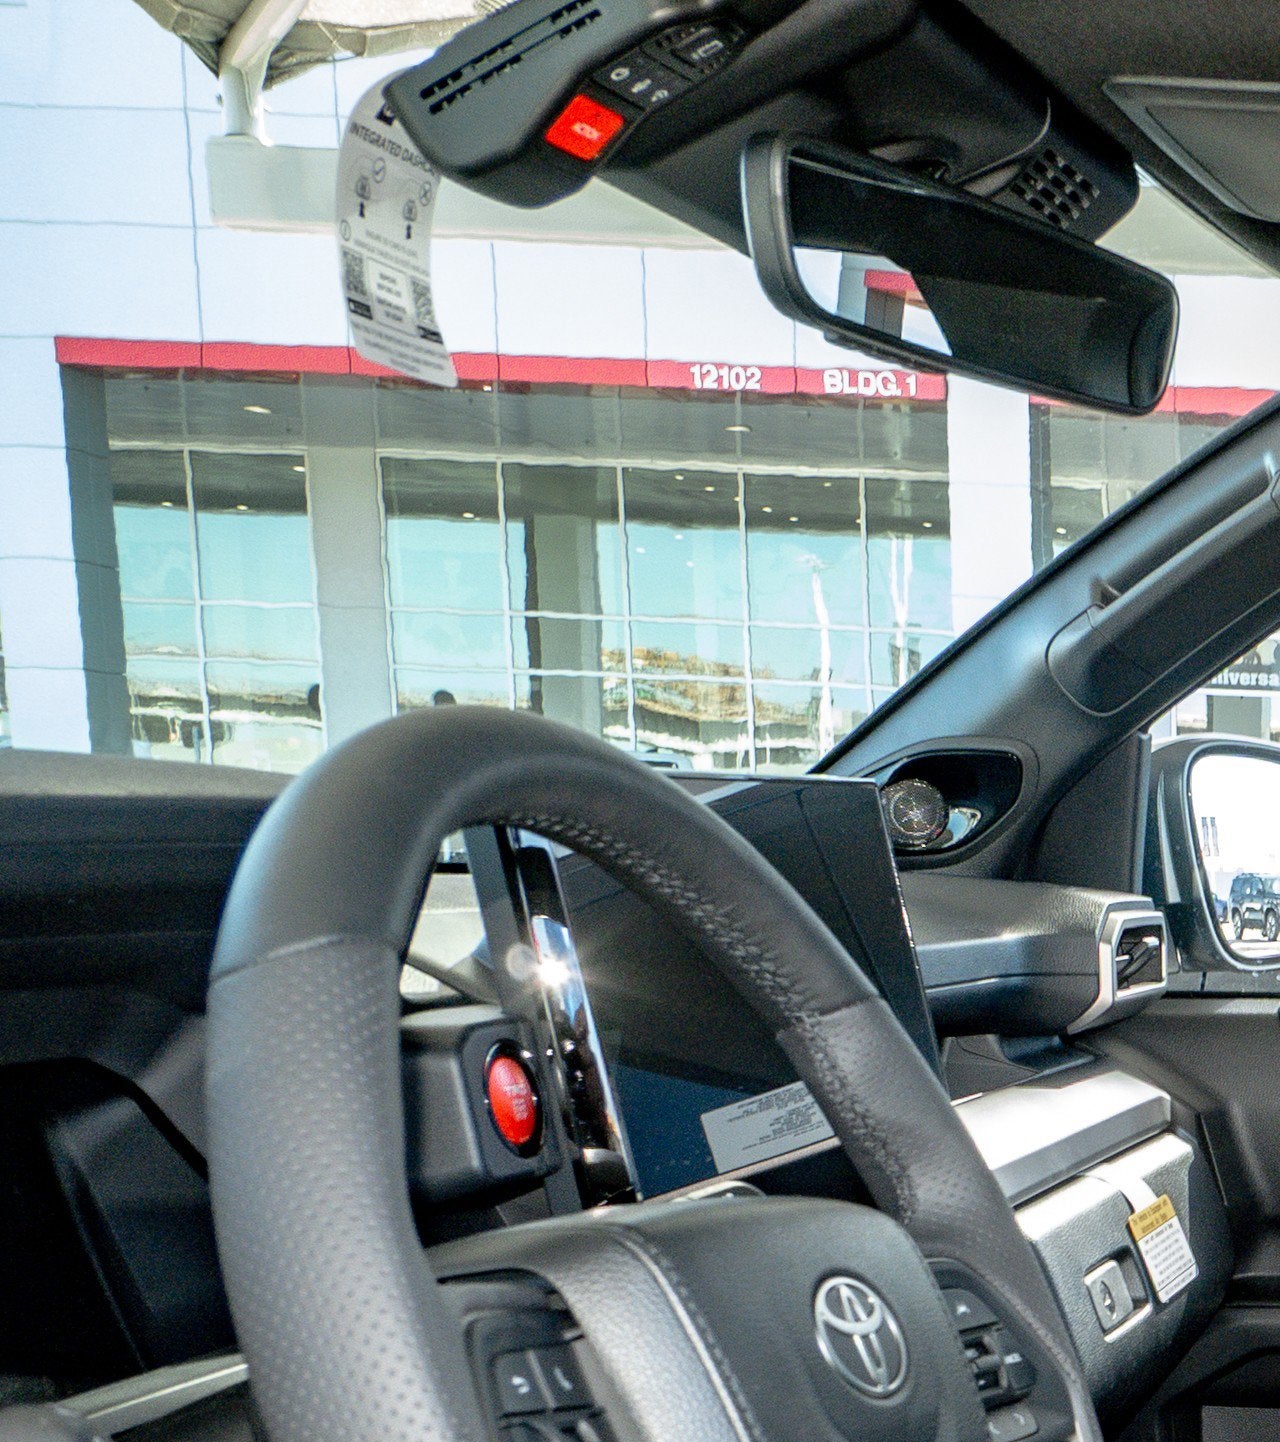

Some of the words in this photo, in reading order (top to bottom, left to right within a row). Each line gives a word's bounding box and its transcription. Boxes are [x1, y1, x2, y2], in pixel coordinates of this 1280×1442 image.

[690, 364, 761, 390] 12102
[823, 370, 900, 396] BLDG.
[906, 374, 917, 396] 1
